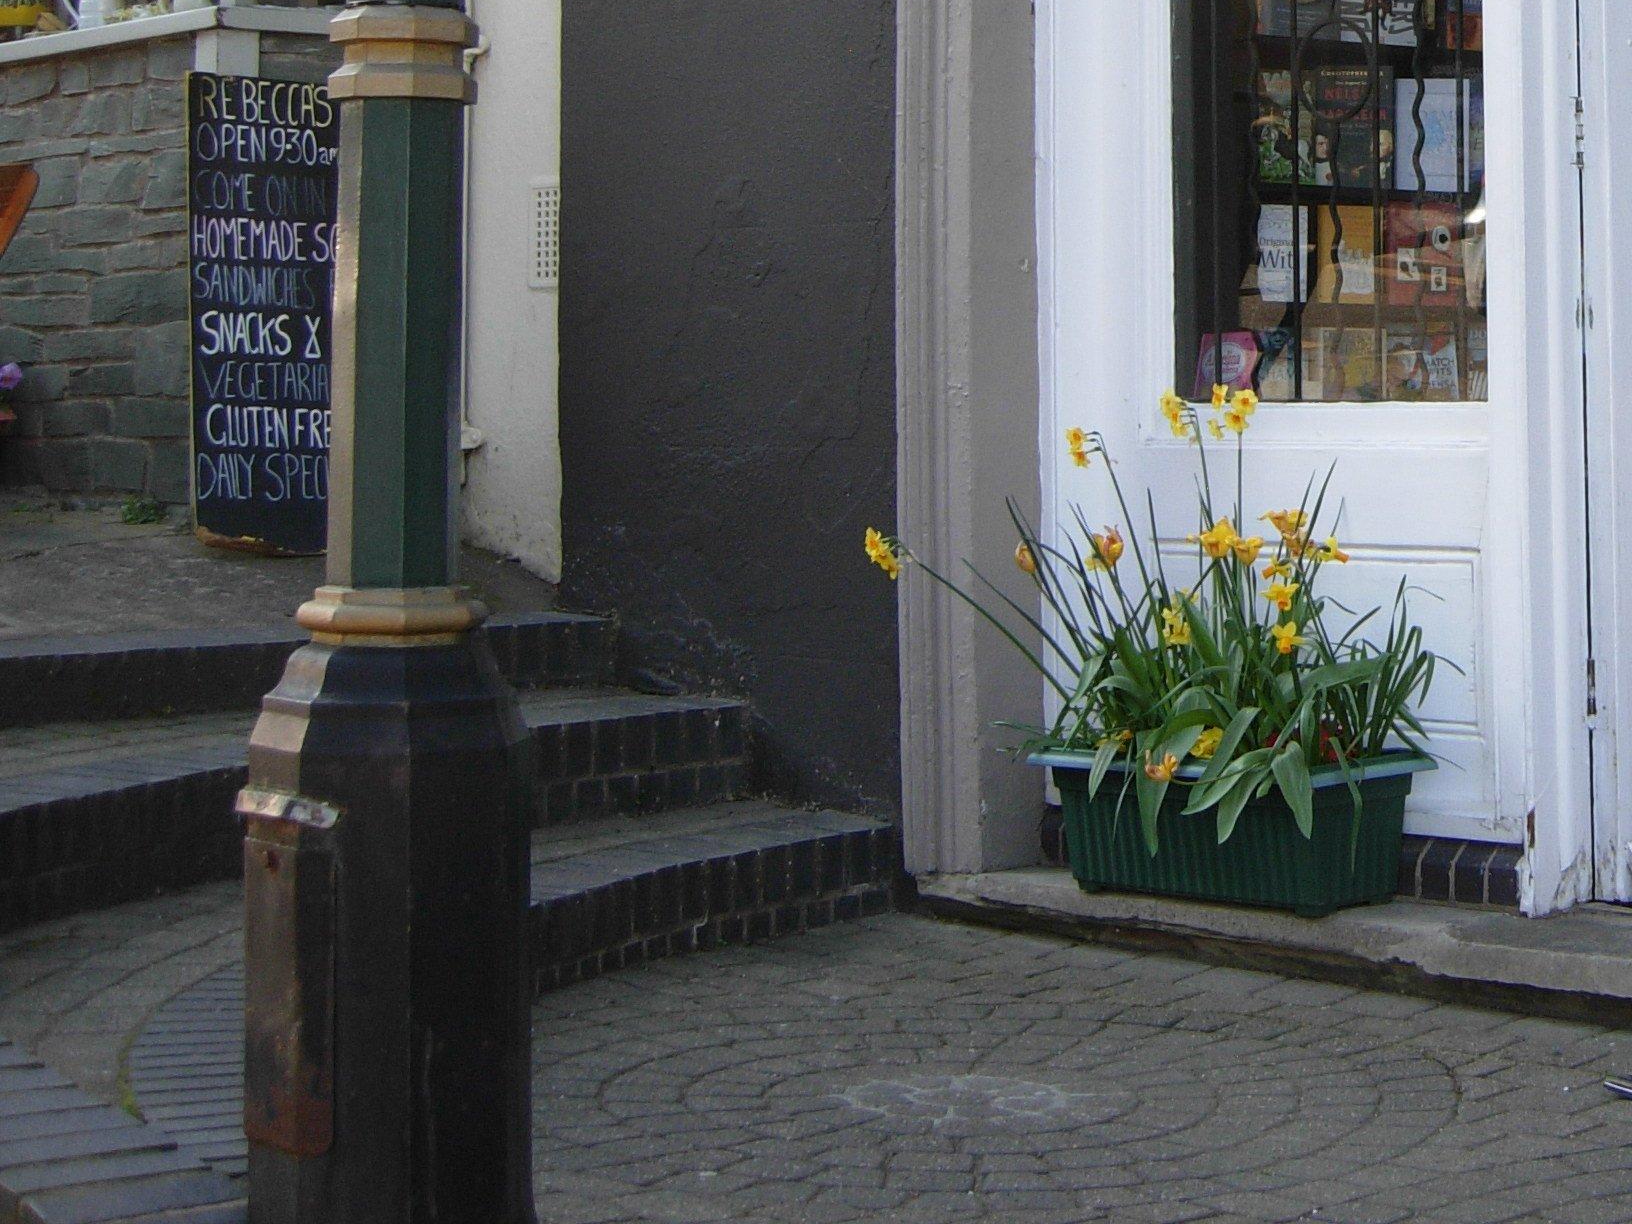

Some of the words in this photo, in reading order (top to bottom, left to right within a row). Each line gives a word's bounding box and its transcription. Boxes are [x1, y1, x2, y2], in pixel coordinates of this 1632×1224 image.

[196, 122, 267, 163] OPEN
[194, 169, 256, 212] COME
[194, 214, 308, 262] HOMEMADE
[194, 261, 316, 309] SANDWICHES
[201, 310, 292, 356] SNACKS
[206, 403, 290, 451] GLUTEN
[198, 452, 256, 500] DAILY
